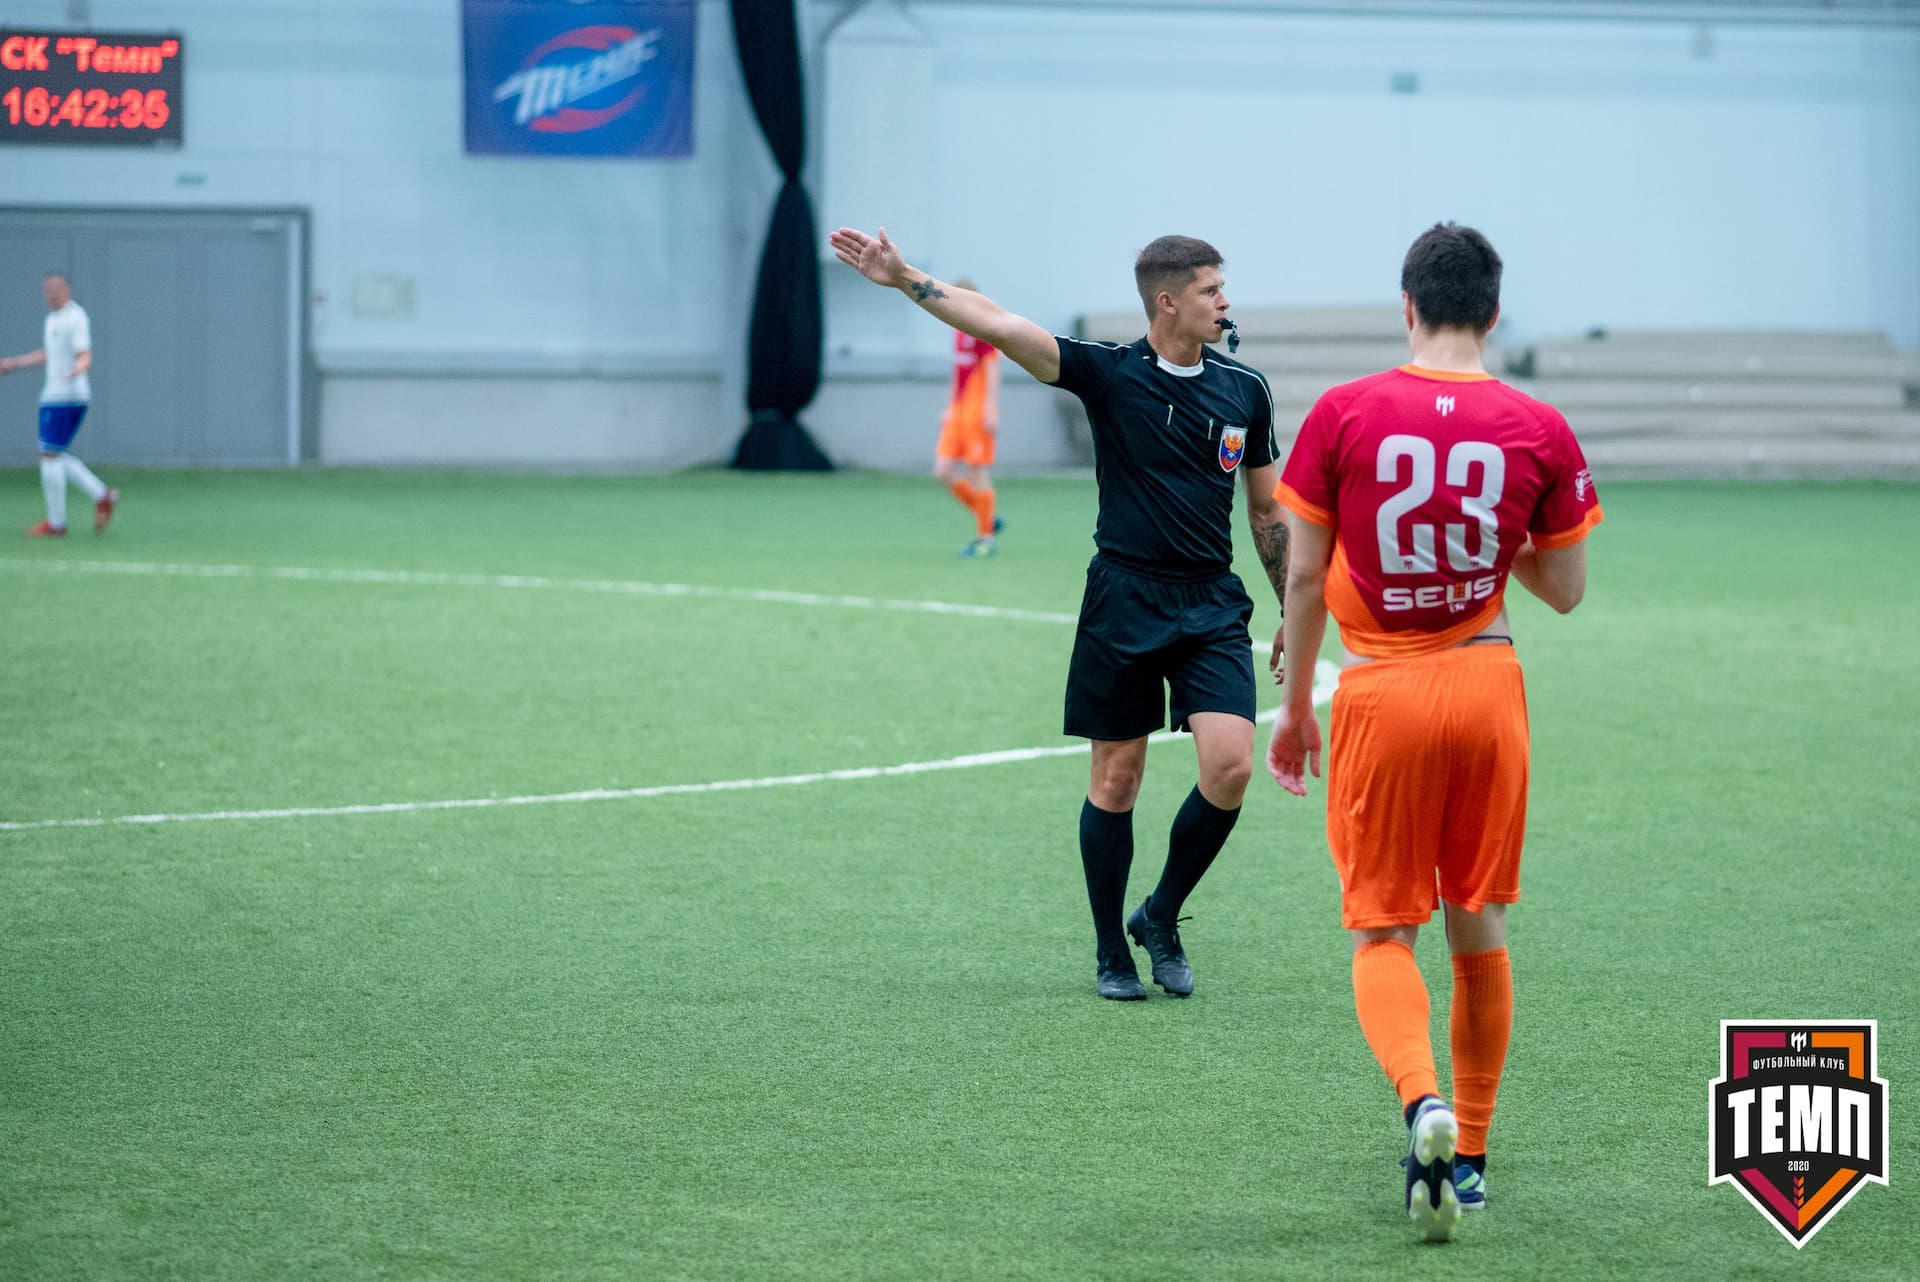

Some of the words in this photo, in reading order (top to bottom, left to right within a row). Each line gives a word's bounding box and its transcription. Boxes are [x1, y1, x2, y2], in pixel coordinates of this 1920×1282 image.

[1, 36, 49, 71] СК
[1376, 434, 1506, 574] 23
[1382, 574, 1498, 611] SEUS
